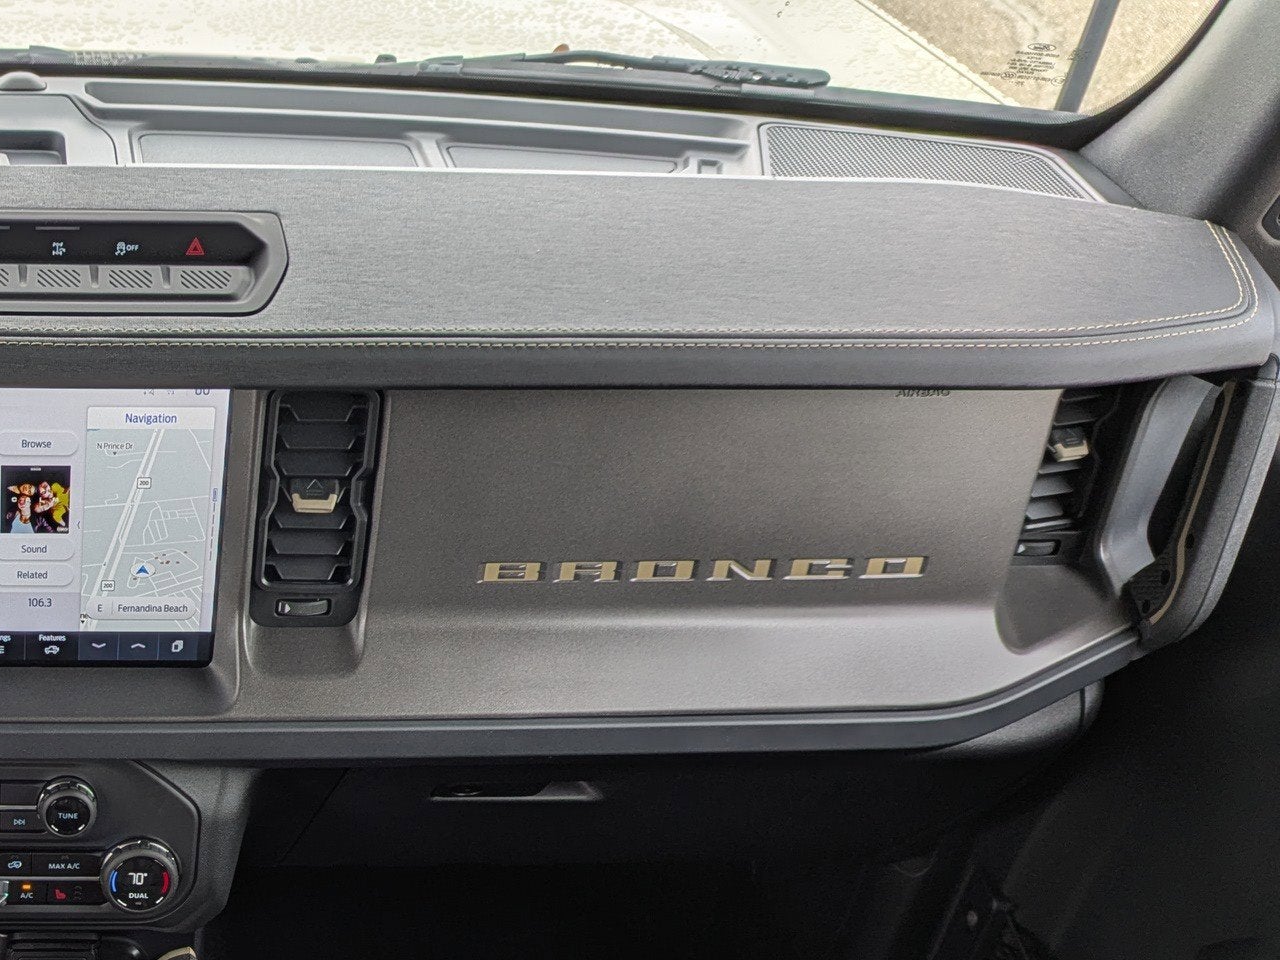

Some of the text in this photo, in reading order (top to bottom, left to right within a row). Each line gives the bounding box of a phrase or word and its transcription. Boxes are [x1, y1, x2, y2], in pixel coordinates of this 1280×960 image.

[126, 244, 139, 252] OFF
[124, 413, 178, 425] Navigation
[21, 439, 52, 449] Browse
[103, 442, 126, 450] Prince
[21, 544, 48, 554] Sound
[477, 556, 926, 584] BRONCO
[17, 570, 48, 580] Related
[27, 598, 53, 608] 106.3
[97, 604, 103, 613] E
[117, 604, 188, 613] Fernandina Beach
[38, 634, 66, 642] Features
[57, 812, 79, 820] TUNE
[48, 862, 81, 870] MAX A/C
